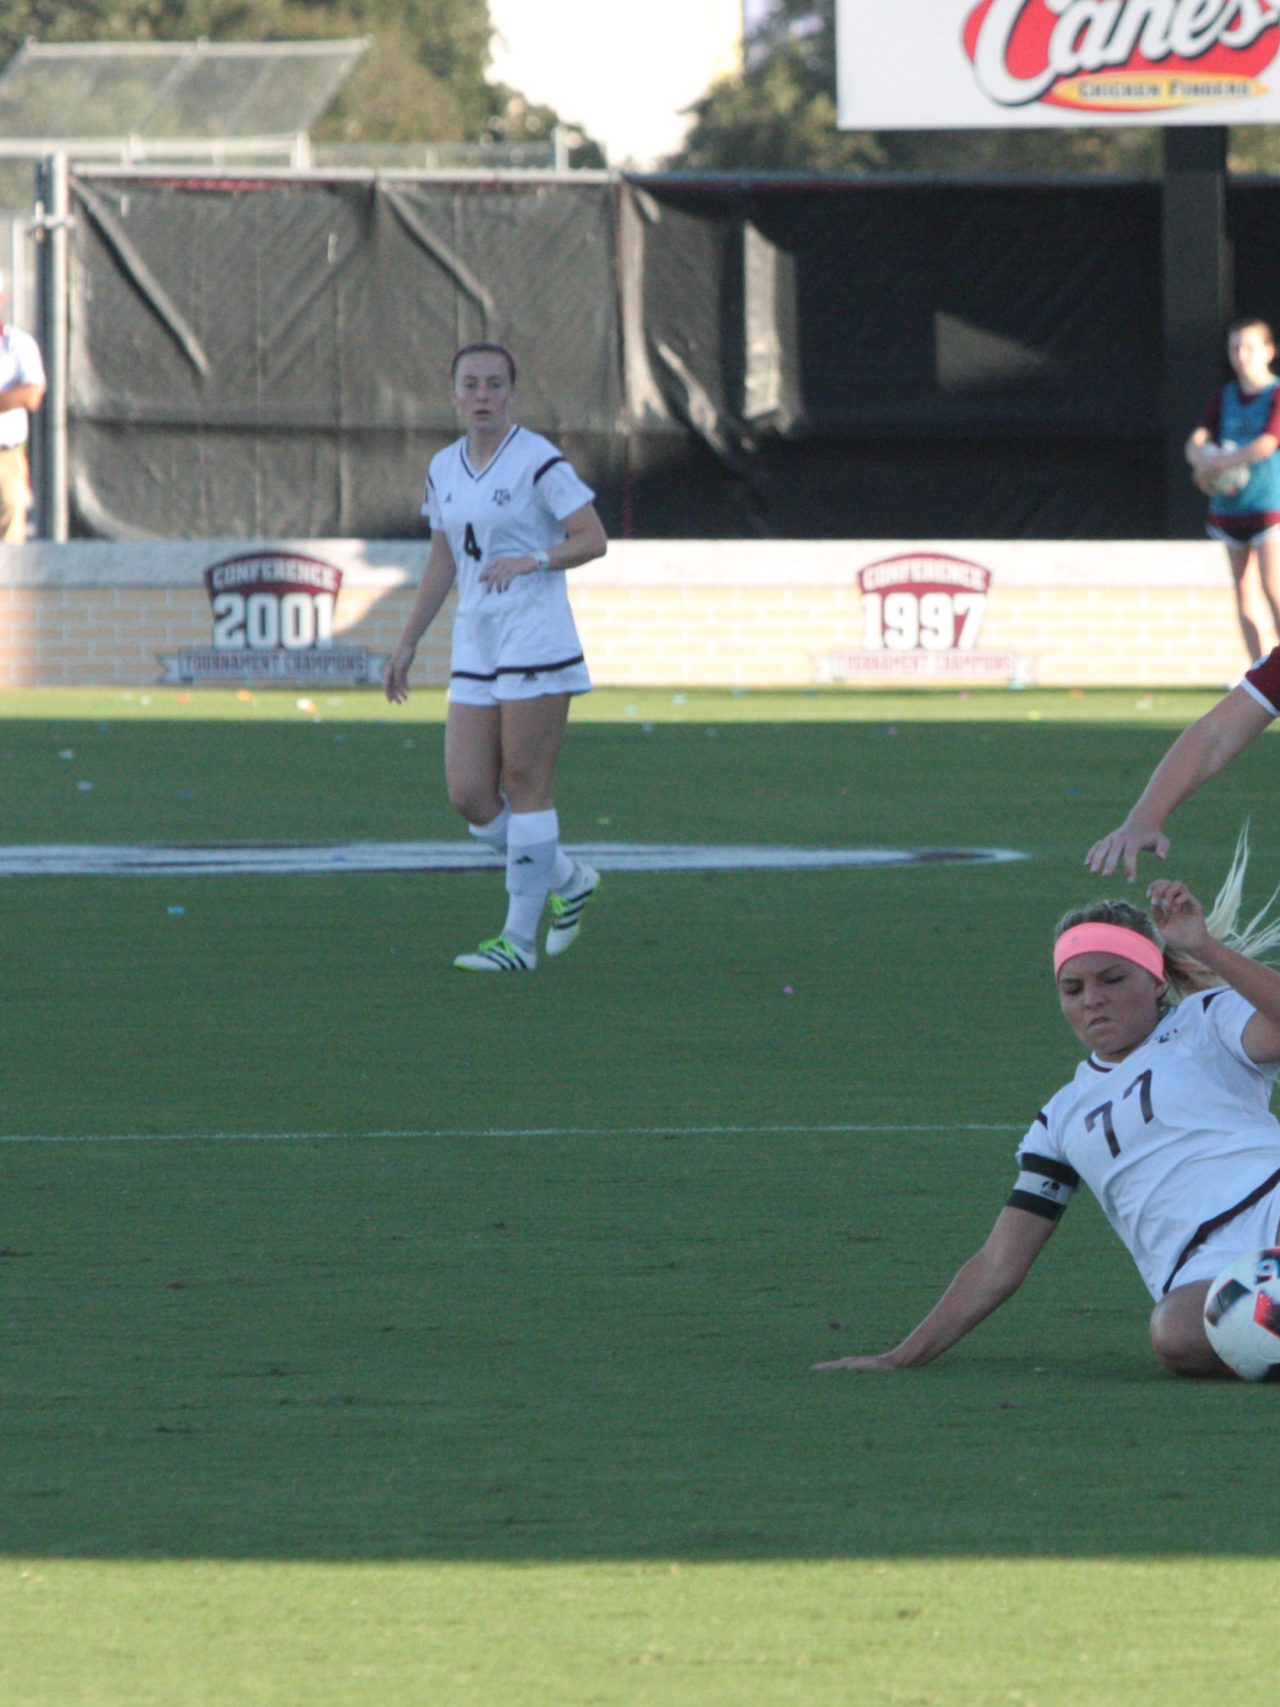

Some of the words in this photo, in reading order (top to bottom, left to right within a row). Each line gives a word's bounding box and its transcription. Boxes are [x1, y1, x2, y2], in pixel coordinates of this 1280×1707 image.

[463, 522, 482, 562] 4
[212, 557, 338, 591] CONFERENCE
[213, 593, 335, 650] 2001
[862, 592, 987, 650] 1997
[1083, 1068, 1155, 1160] 77
